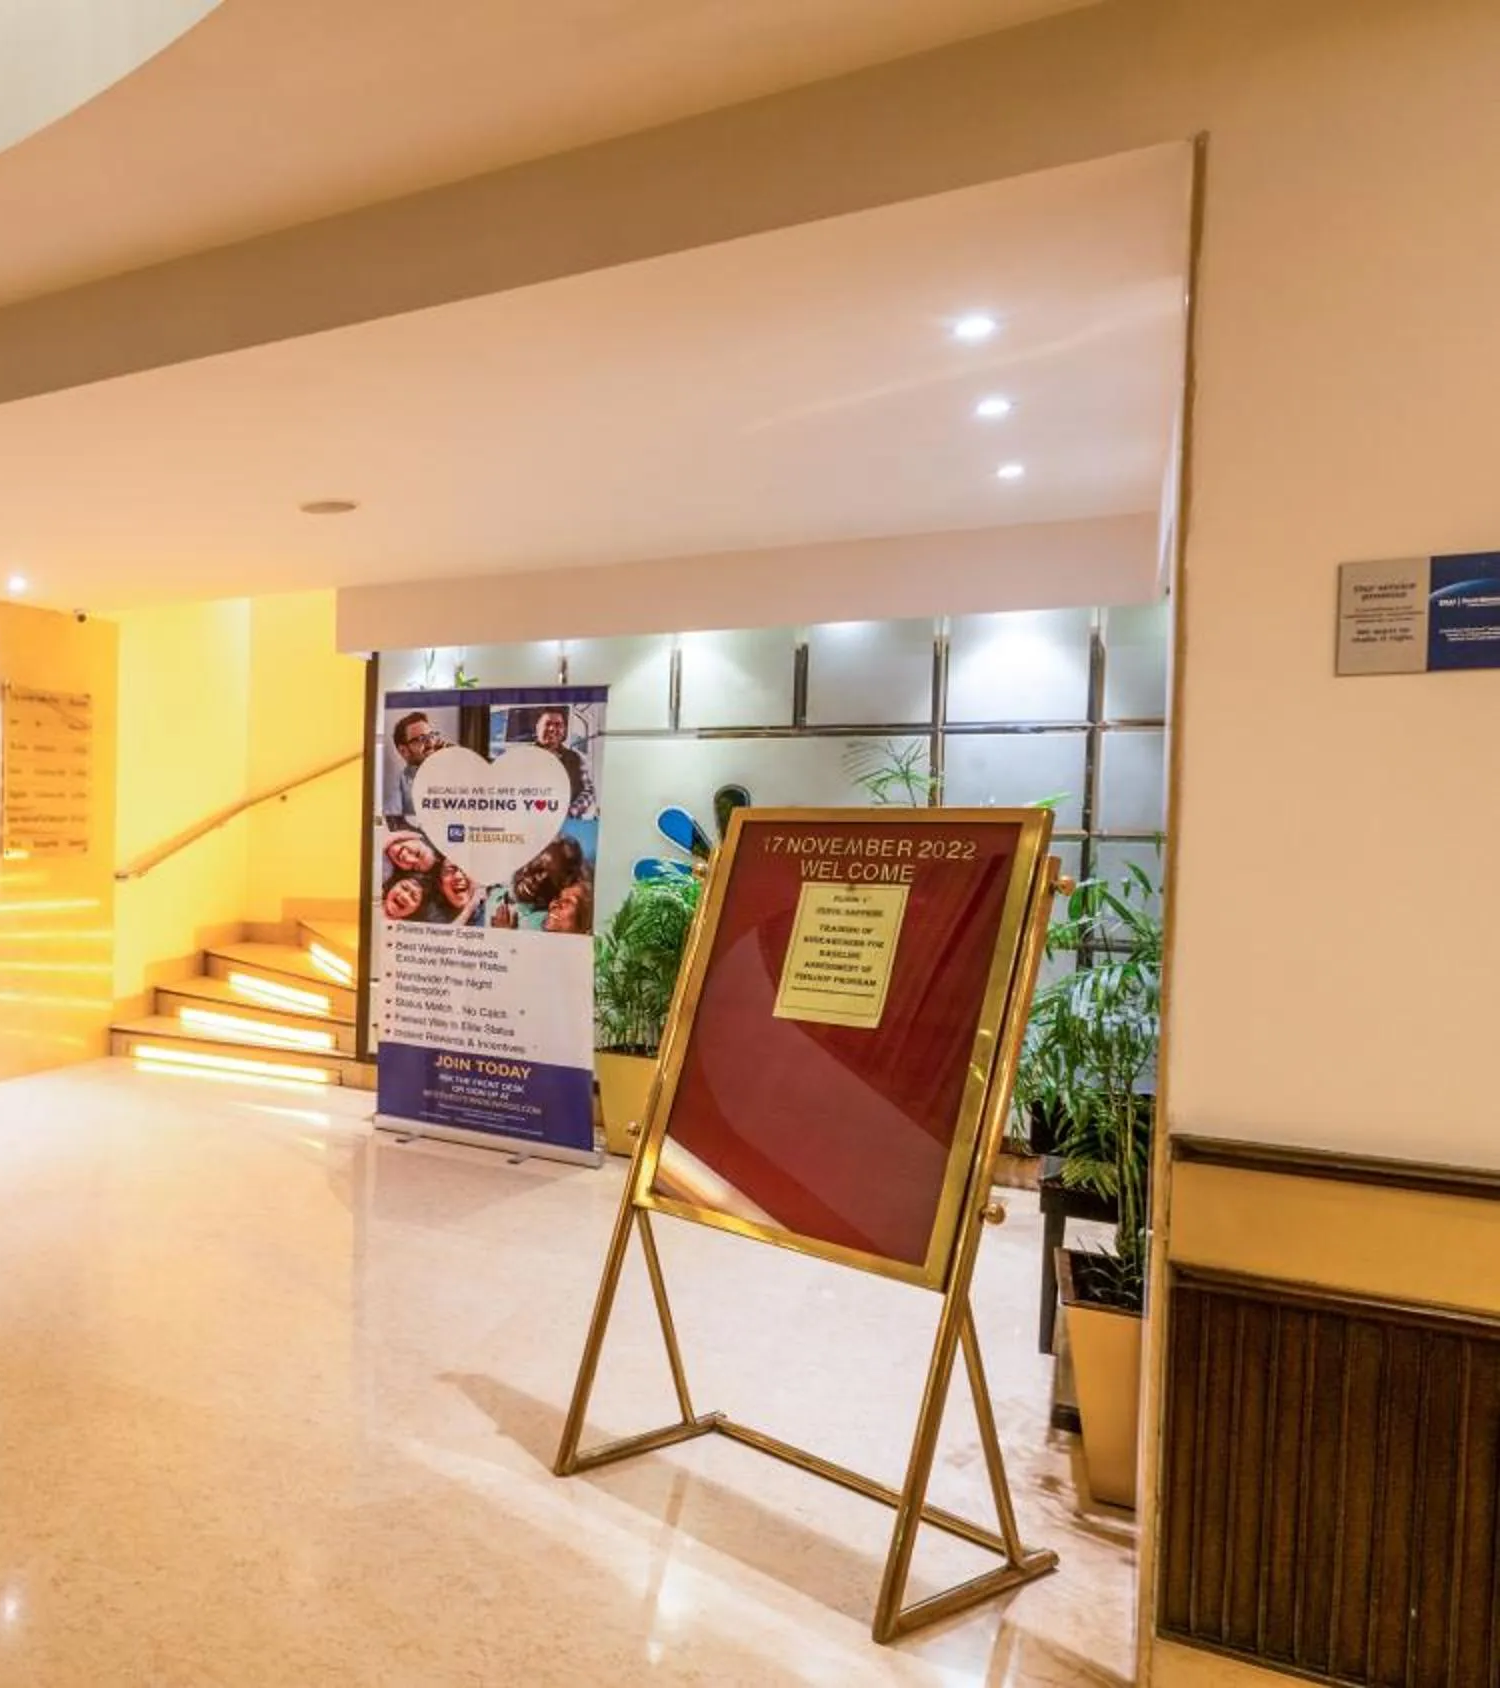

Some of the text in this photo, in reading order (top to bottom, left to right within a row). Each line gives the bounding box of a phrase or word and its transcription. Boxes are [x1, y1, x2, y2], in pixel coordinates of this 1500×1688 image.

[421, 797, 517, 811] REWARDING
[786, 836, 914, 858] NOVEMBER
[916, 840, 977, 860] 2022
[800, 859, 916, 883] WELCOME
[395, 941, 499, 959] Best Western Rewards
[395, 998, 423, 1010] Status
[434, 1055, 532, 1080] JOIN TODAY
